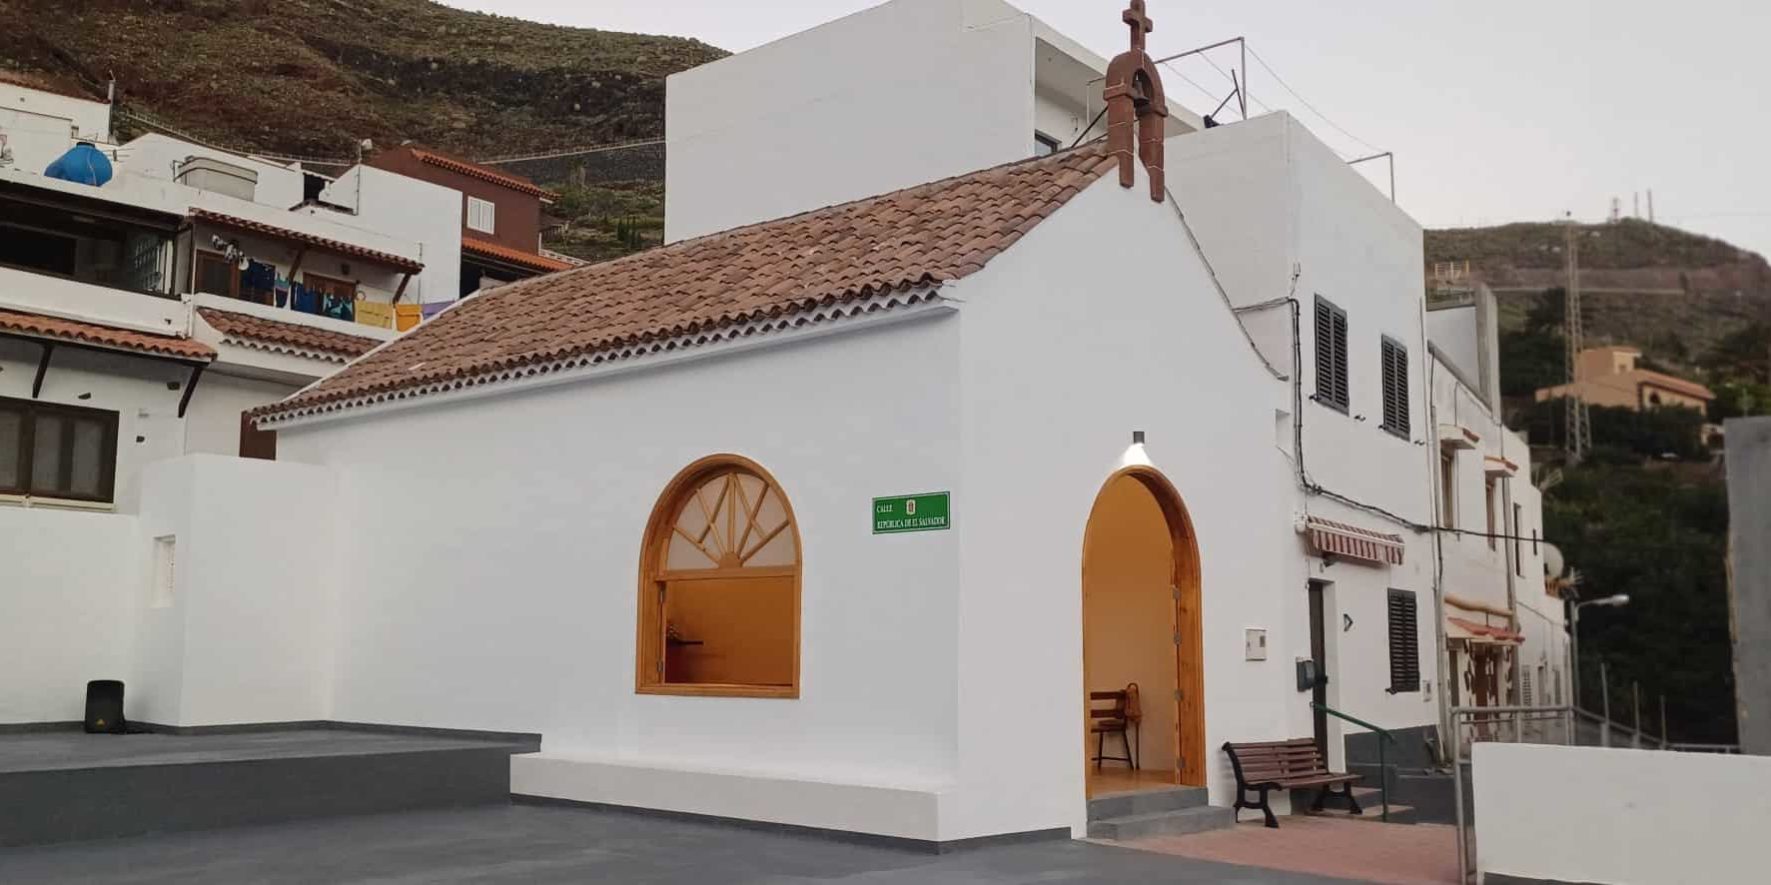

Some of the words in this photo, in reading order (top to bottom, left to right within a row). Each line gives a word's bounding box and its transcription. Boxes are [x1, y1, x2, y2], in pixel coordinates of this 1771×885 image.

[877, 504, 893, 513] CALLE
[905, 518, 911, 527] DE
[912, 518, 918, 527] EL
[919, 516, 945, 526] SALVADOR
